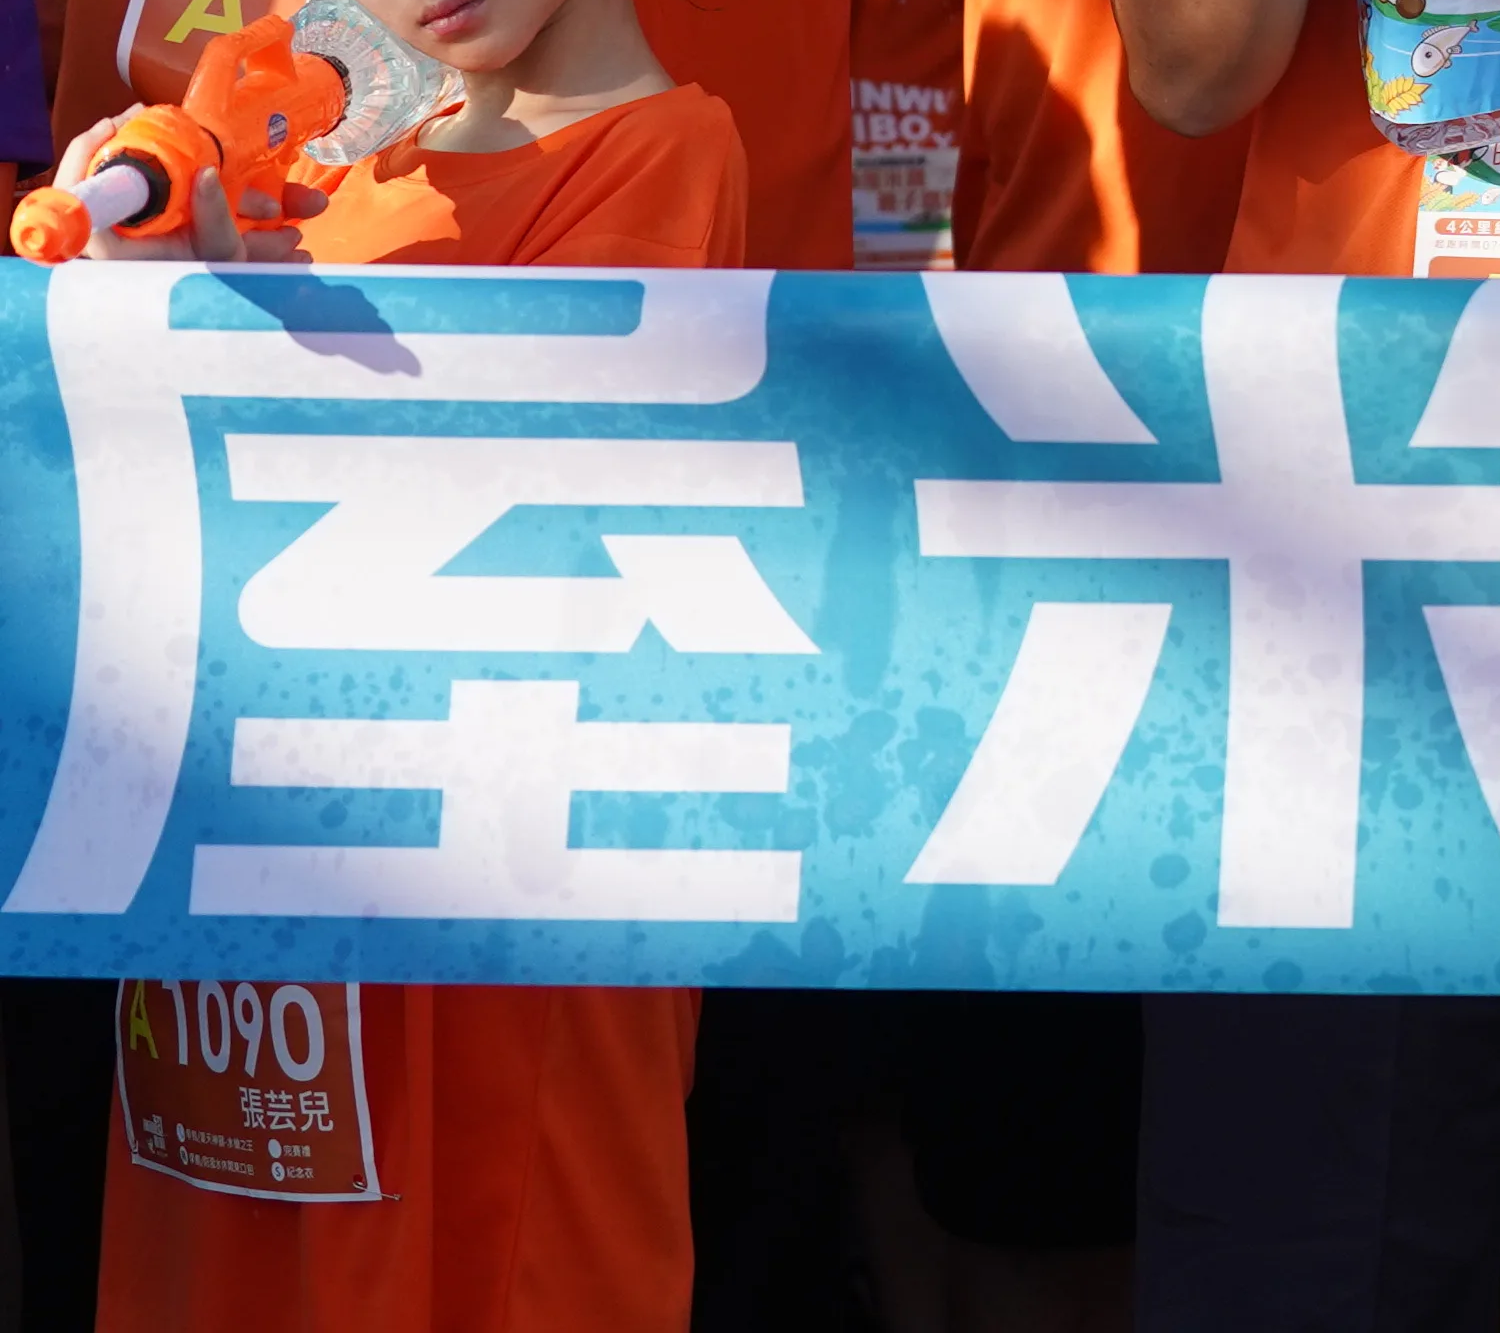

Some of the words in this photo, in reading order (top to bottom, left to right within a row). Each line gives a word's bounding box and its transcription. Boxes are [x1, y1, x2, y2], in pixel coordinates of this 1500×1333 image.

[162, 979, 325, 1081] 1090
[239, 1086, 334, 1132] 張芸兒
